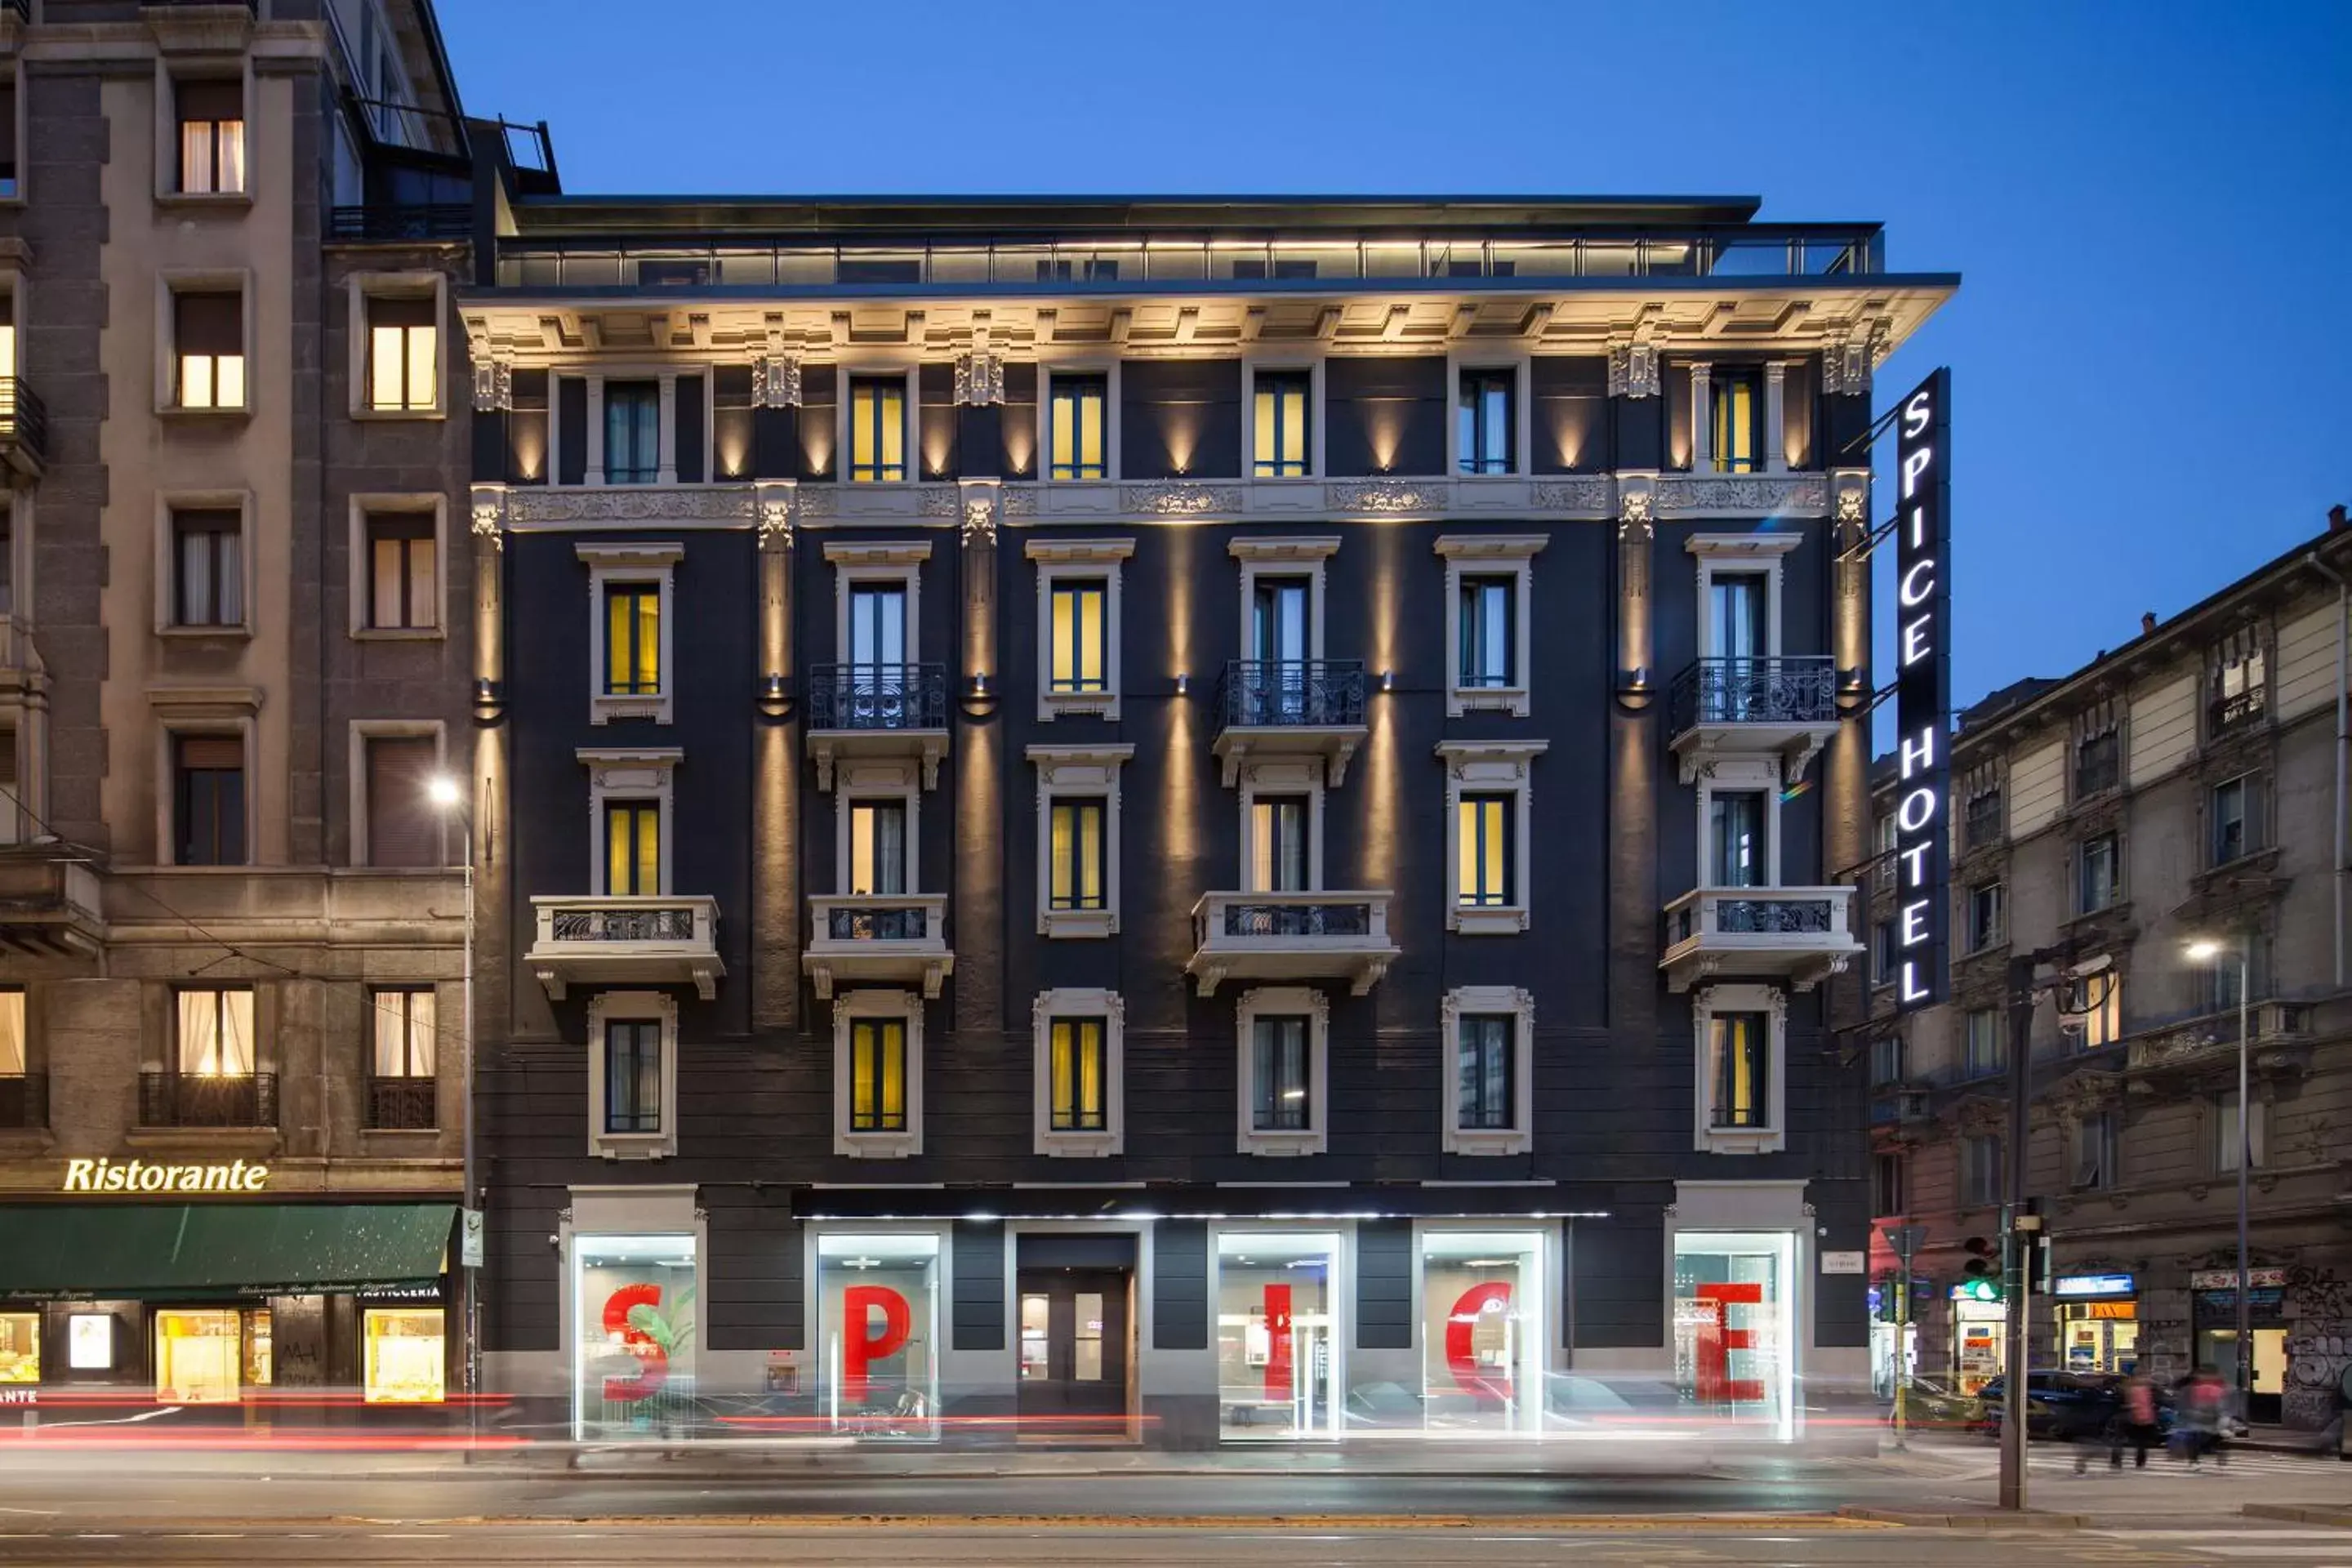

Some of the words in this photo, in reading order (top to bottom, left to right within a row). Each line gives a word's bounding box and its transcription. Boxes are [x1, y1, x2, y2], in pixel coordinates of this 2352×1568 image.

[1900, 391, 1935, 666] SPICE
[1898, 726, 1936, 1003] HOTEL
[63, 1157, 269, 1191] Ristorante
